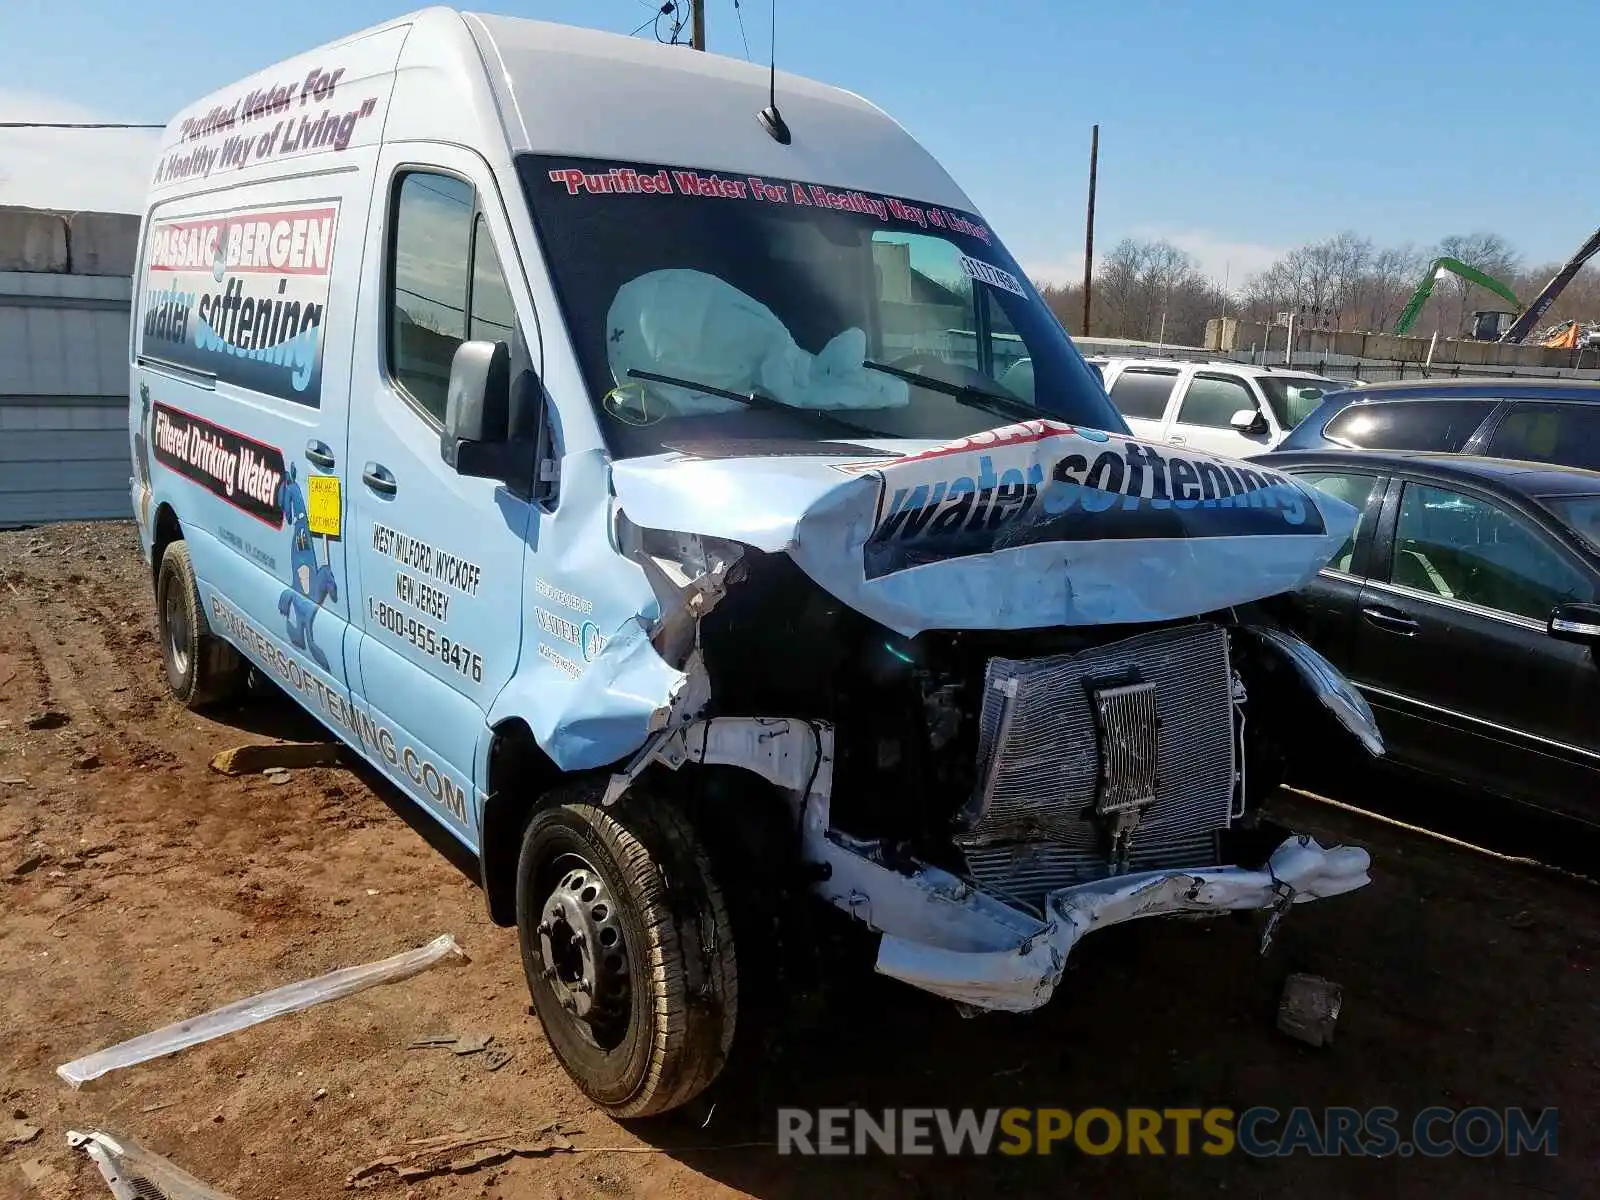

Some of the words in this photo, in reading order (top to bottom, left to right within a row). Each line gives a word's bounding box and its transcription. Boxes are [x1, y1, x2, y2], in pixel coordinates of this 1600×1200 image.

[241, 81, 299, 125] Water
[300, 66, 346, 107] For
[153, 157, 165, 185] A
[164, 144, 220, 178] Healthy
[220, 133, 258, 170] Way
[256, 120, 284, 159] of
[280, 96, 378, 151] Living"
[549, 168, 674, 195] "Purified
[672, 171, 747, 199] Water
[748, 177, 788, 204] For
[791, 182, 812, 206] A
[808, 185, 889, 222] Healthy
[885, 197, 929, 229] Way
[927, 208, 946, 228] of
[152, 226, 219, 267] PASSAIC
[226, 217, 331, 268] BERGEN
[144, 278, 196, 344] water
[195, 277, 323, 391] softening
[155, 411, 190, 459] Filtered
[190, 425, 237, 496] Drinking
[238, 446, 282, 506] Water
[1044, 443, 1306, 524] softening
[372, 523, 394, 555] WEST
[435, 550, 481, 597] WYCKOFF
[396, 572, 415, 604] NEW
[414, 582, 451, 624] JERSEY
[368, 596, 483, 683] 1-800-955-8476
